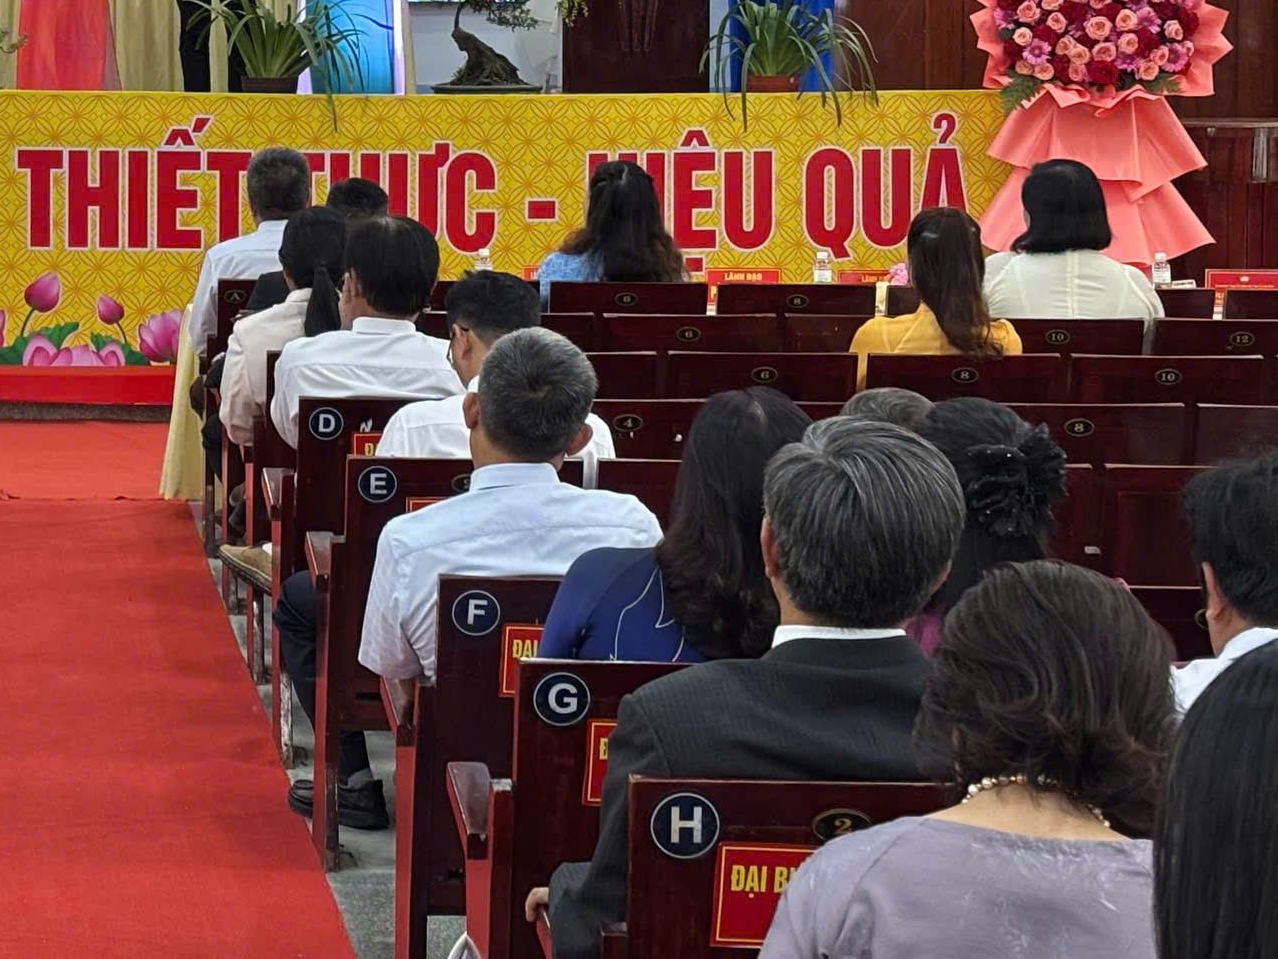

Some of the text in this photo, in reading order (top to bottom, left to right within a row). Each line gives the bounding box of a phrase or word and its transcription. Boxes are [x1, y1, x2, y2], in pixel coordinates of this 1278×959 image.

[17, 118, 255, 248] THIẾT
[528, 201, 556, 219] -
[806, 113, 968, 258] QUẢ
[685, 331, 693, 339] 6
[1052, 333, 1064, 341] 10
[761, 371, 769, 380] 6
[961, 371, 969, 379] 8
[1161, 373, 1175, 382] 10
[319, 414, 336, 432] D
[624, 419, 633, 428] 4
[1074, 423, 1084, 433] 8
[370, 473, 387, 494] E
[466, 600, 488, 624] F
[548, 683, 578, 714] G
[671, 806, 702, 843] H
[834, 818, 852, 835] 2
[731, 865, 768, 899] ĐẠI
